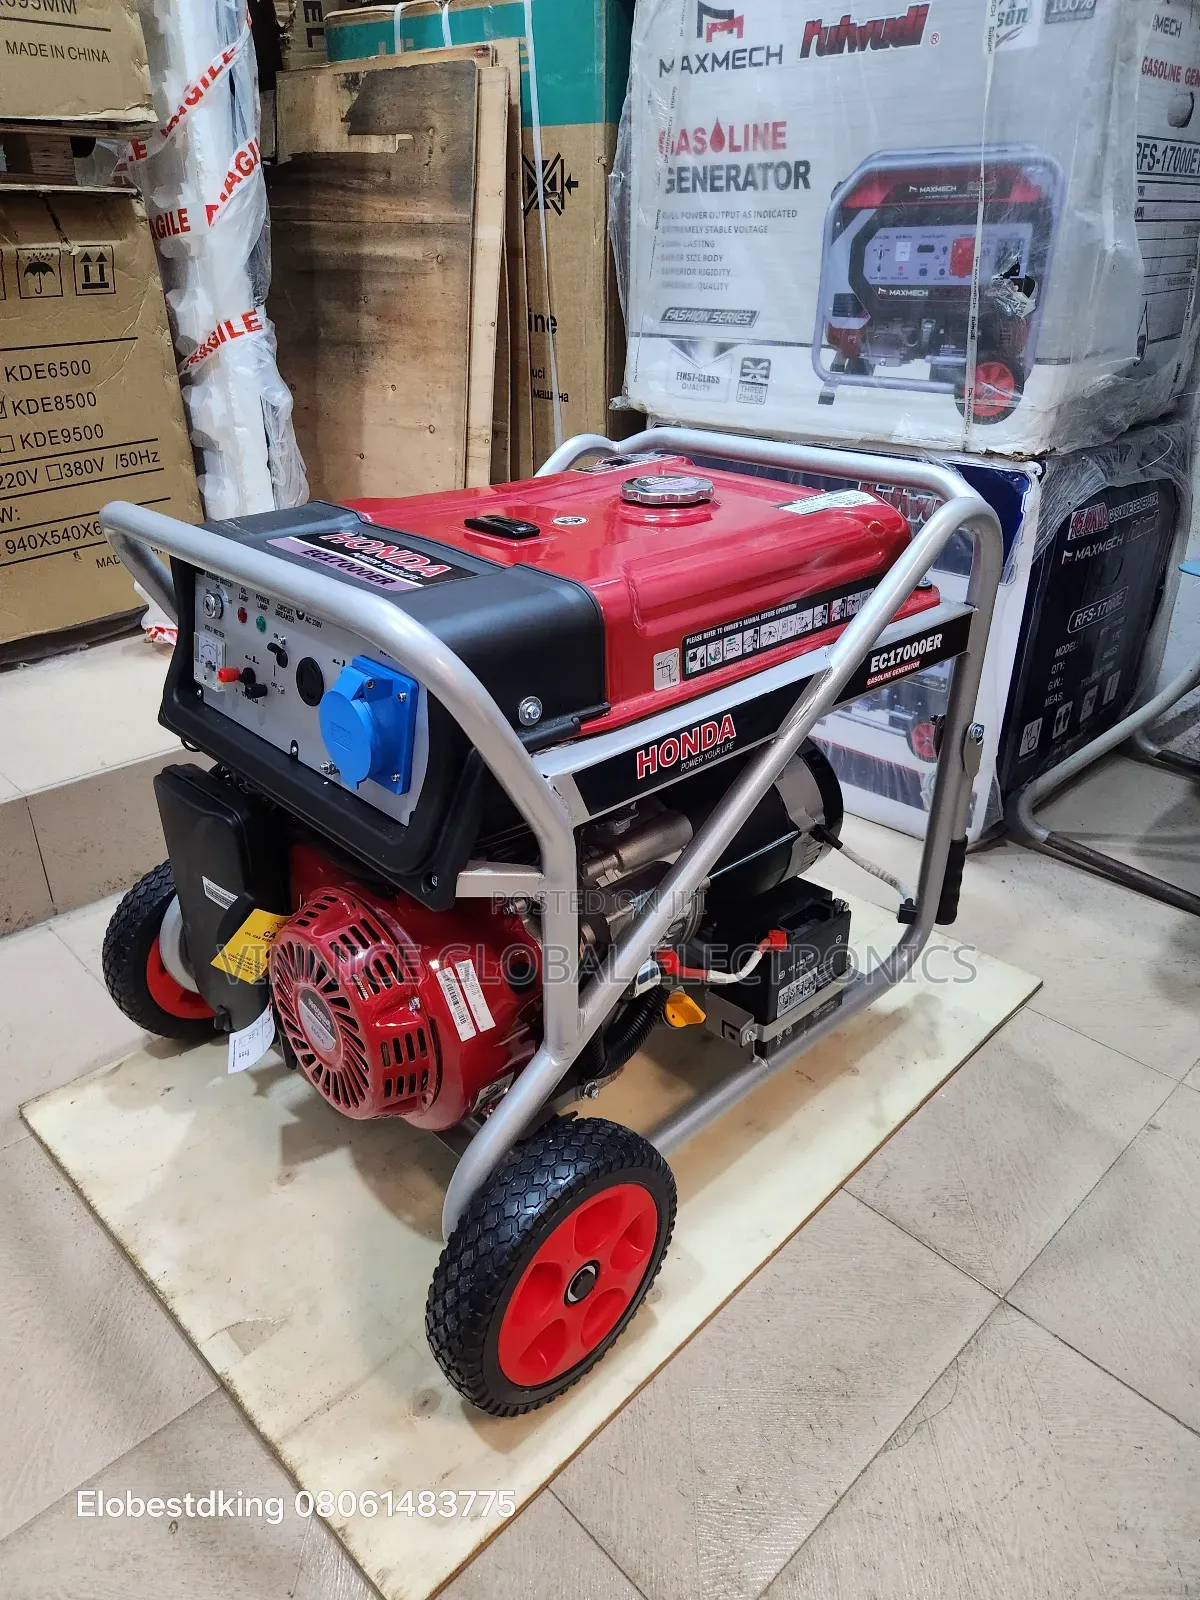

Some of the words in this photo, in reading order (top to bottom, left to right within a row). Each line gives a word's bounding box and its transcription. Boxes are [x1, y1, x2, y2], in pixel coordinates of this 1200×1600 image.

[5, 40, 49, 58] MADE
[50, 44, 65, 60] IN
[67, 46, 111, 63] CHINA
[659, 44, 783, 77] MAXMECH
[1141, 56, 1182, 83] GASOLINE
[680, 211, 707, 220] POWER
[709, 210, 740, 219] OUTPUT
[742, 210, 752, 218] AS
[753, 209, 798, 219] INDICATED
[705, 226, 732, 234] STABLE
[734, 226, 768, 234] VOLTAGE
[702, 254, 724, 262] BODY
[698, 268, 731, 276] RIGIDITY
[698, 282, 730, 291] QUALITY
[889, 289, 929, 297] MAXMECH
[665, 309, 711, 321] FASHION
[711, 311, 753, 324] SERIES
[5, 359, 91, 382] KDE6500
[676, 371, 720, 384] FIRST-CLASS
[681, 382, 711, 392] QUALITY
[741, 385, 764, 394] THREE
[12, 391, 97, 416] KDE8500
[739, 394, 764, 402] PHASE
[20, 424, 104, 449] KDE9500
[63, 457, 104, 478] 380V
[115, 449, 160, 469] /50Hz
[1075, 533, 1125, 561] MAXMECH
[319, 533, 452, 578] HONDA
[301, 549, 396, 586] EC17000ER
[255, 593, 270, 605] POWER
[275, 609, 295, 624] BREAKER
[276, 603, 293, 614] CIRCUIT
[686, 635, 702, 645] PLEASE
[703, 629, 716, 640] REFER
[870, 633, 943, 673] EC17000ER
[866, 671, 892, 686] GASOLINE
[892, 661, 921, 676] GENERATOR
[637, 713, 736, 780] HONDA
[680, 755, 704, 772] POWER
[704, 748, 721, 761] YOUR
[721, 741, 735, 753] LIFE
